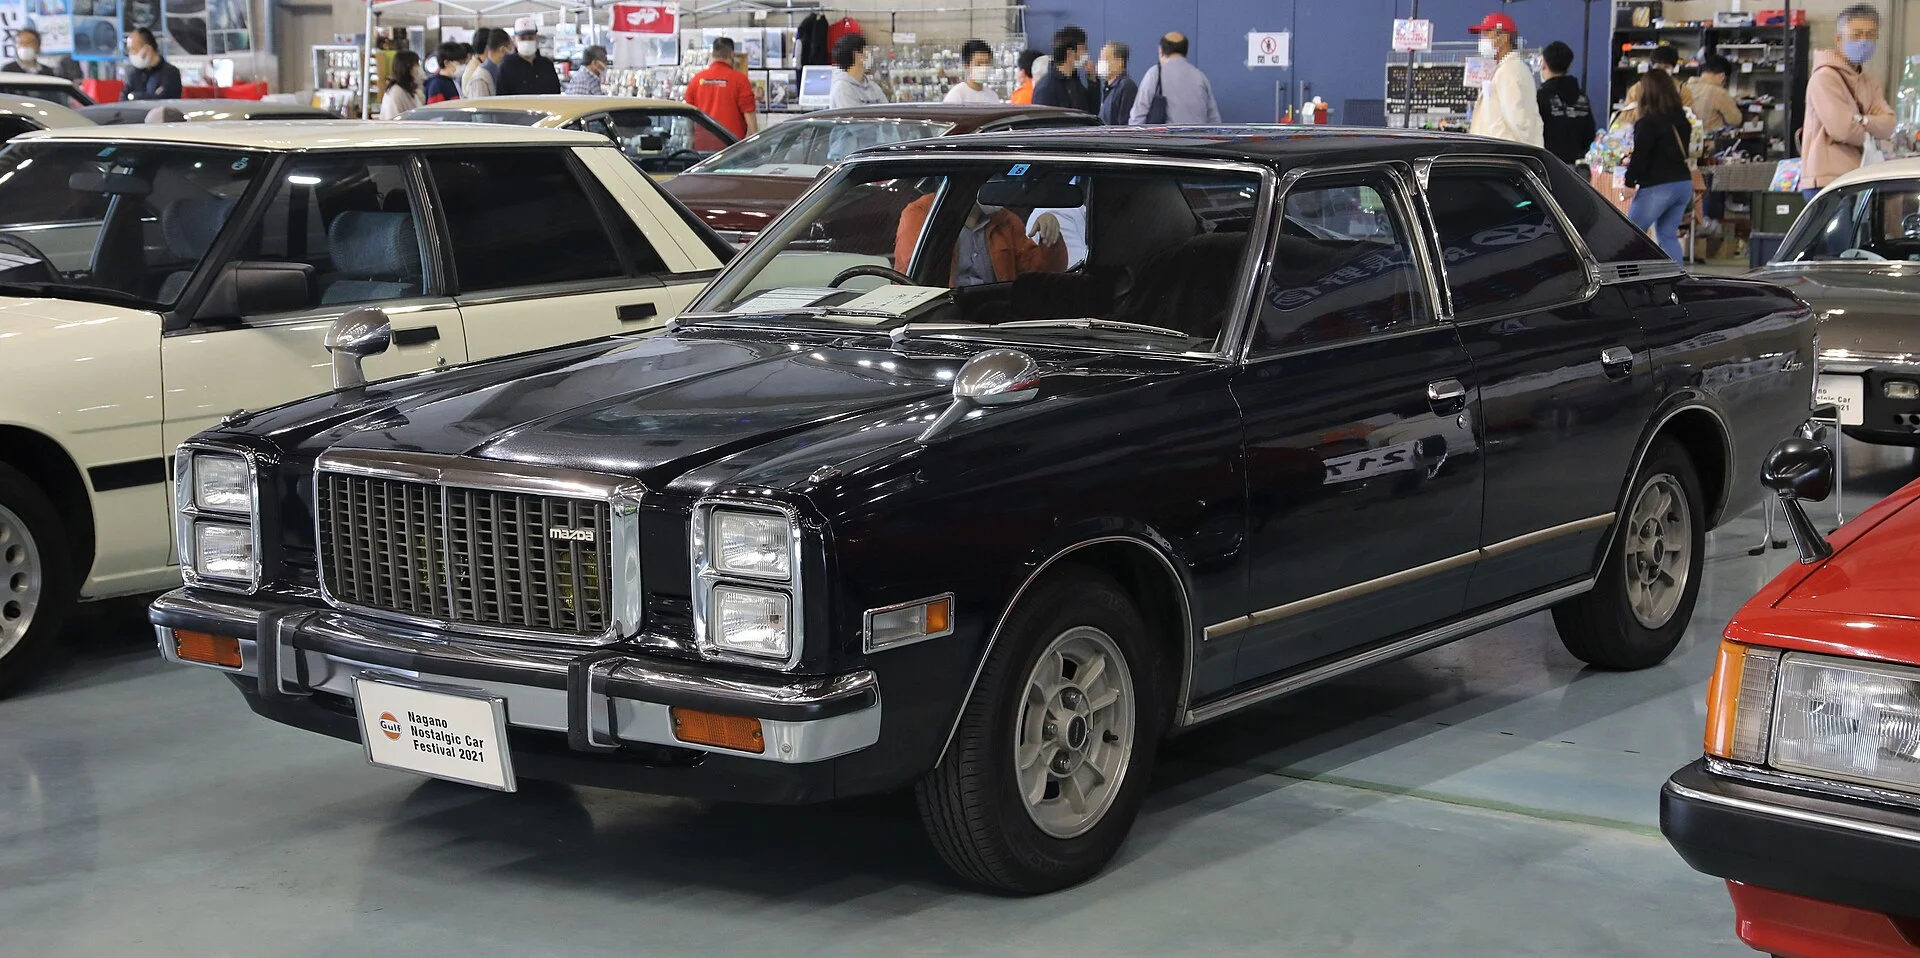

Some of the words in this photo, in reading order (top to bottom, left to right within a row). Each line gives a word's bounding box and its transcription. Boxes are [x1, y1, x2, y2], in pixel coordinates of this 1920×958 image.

[380, 720, 402, 732] Gulf
[408, 711, 448, 728] Nagano
[411, 725, 461, 745] Nostalgic
[465, 735, 484, 748] Car
[413, 740, 456, 758] Festival
[459, 748, 484, 762] 2021
